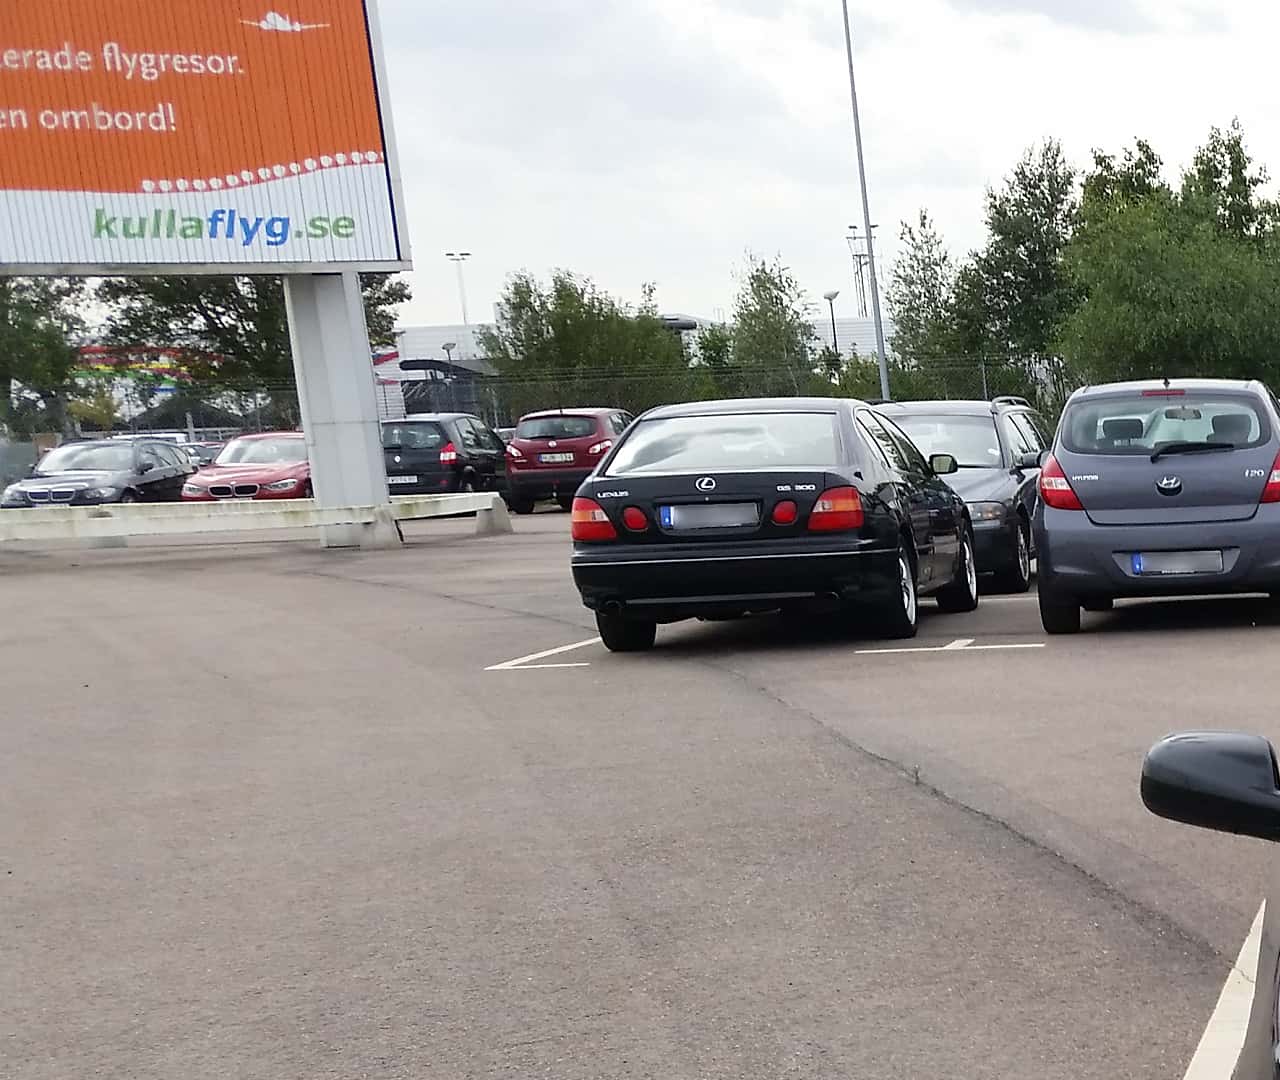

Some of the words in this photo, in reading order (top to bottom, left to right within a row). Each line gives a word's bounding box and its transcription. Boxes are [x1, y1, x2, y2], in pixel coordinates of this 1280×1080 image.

[103, 41, 245, 80] flygresor.
[39, 102, 177, 131] ombord!
[93, 208, 356, 246] kullaflyg.se
